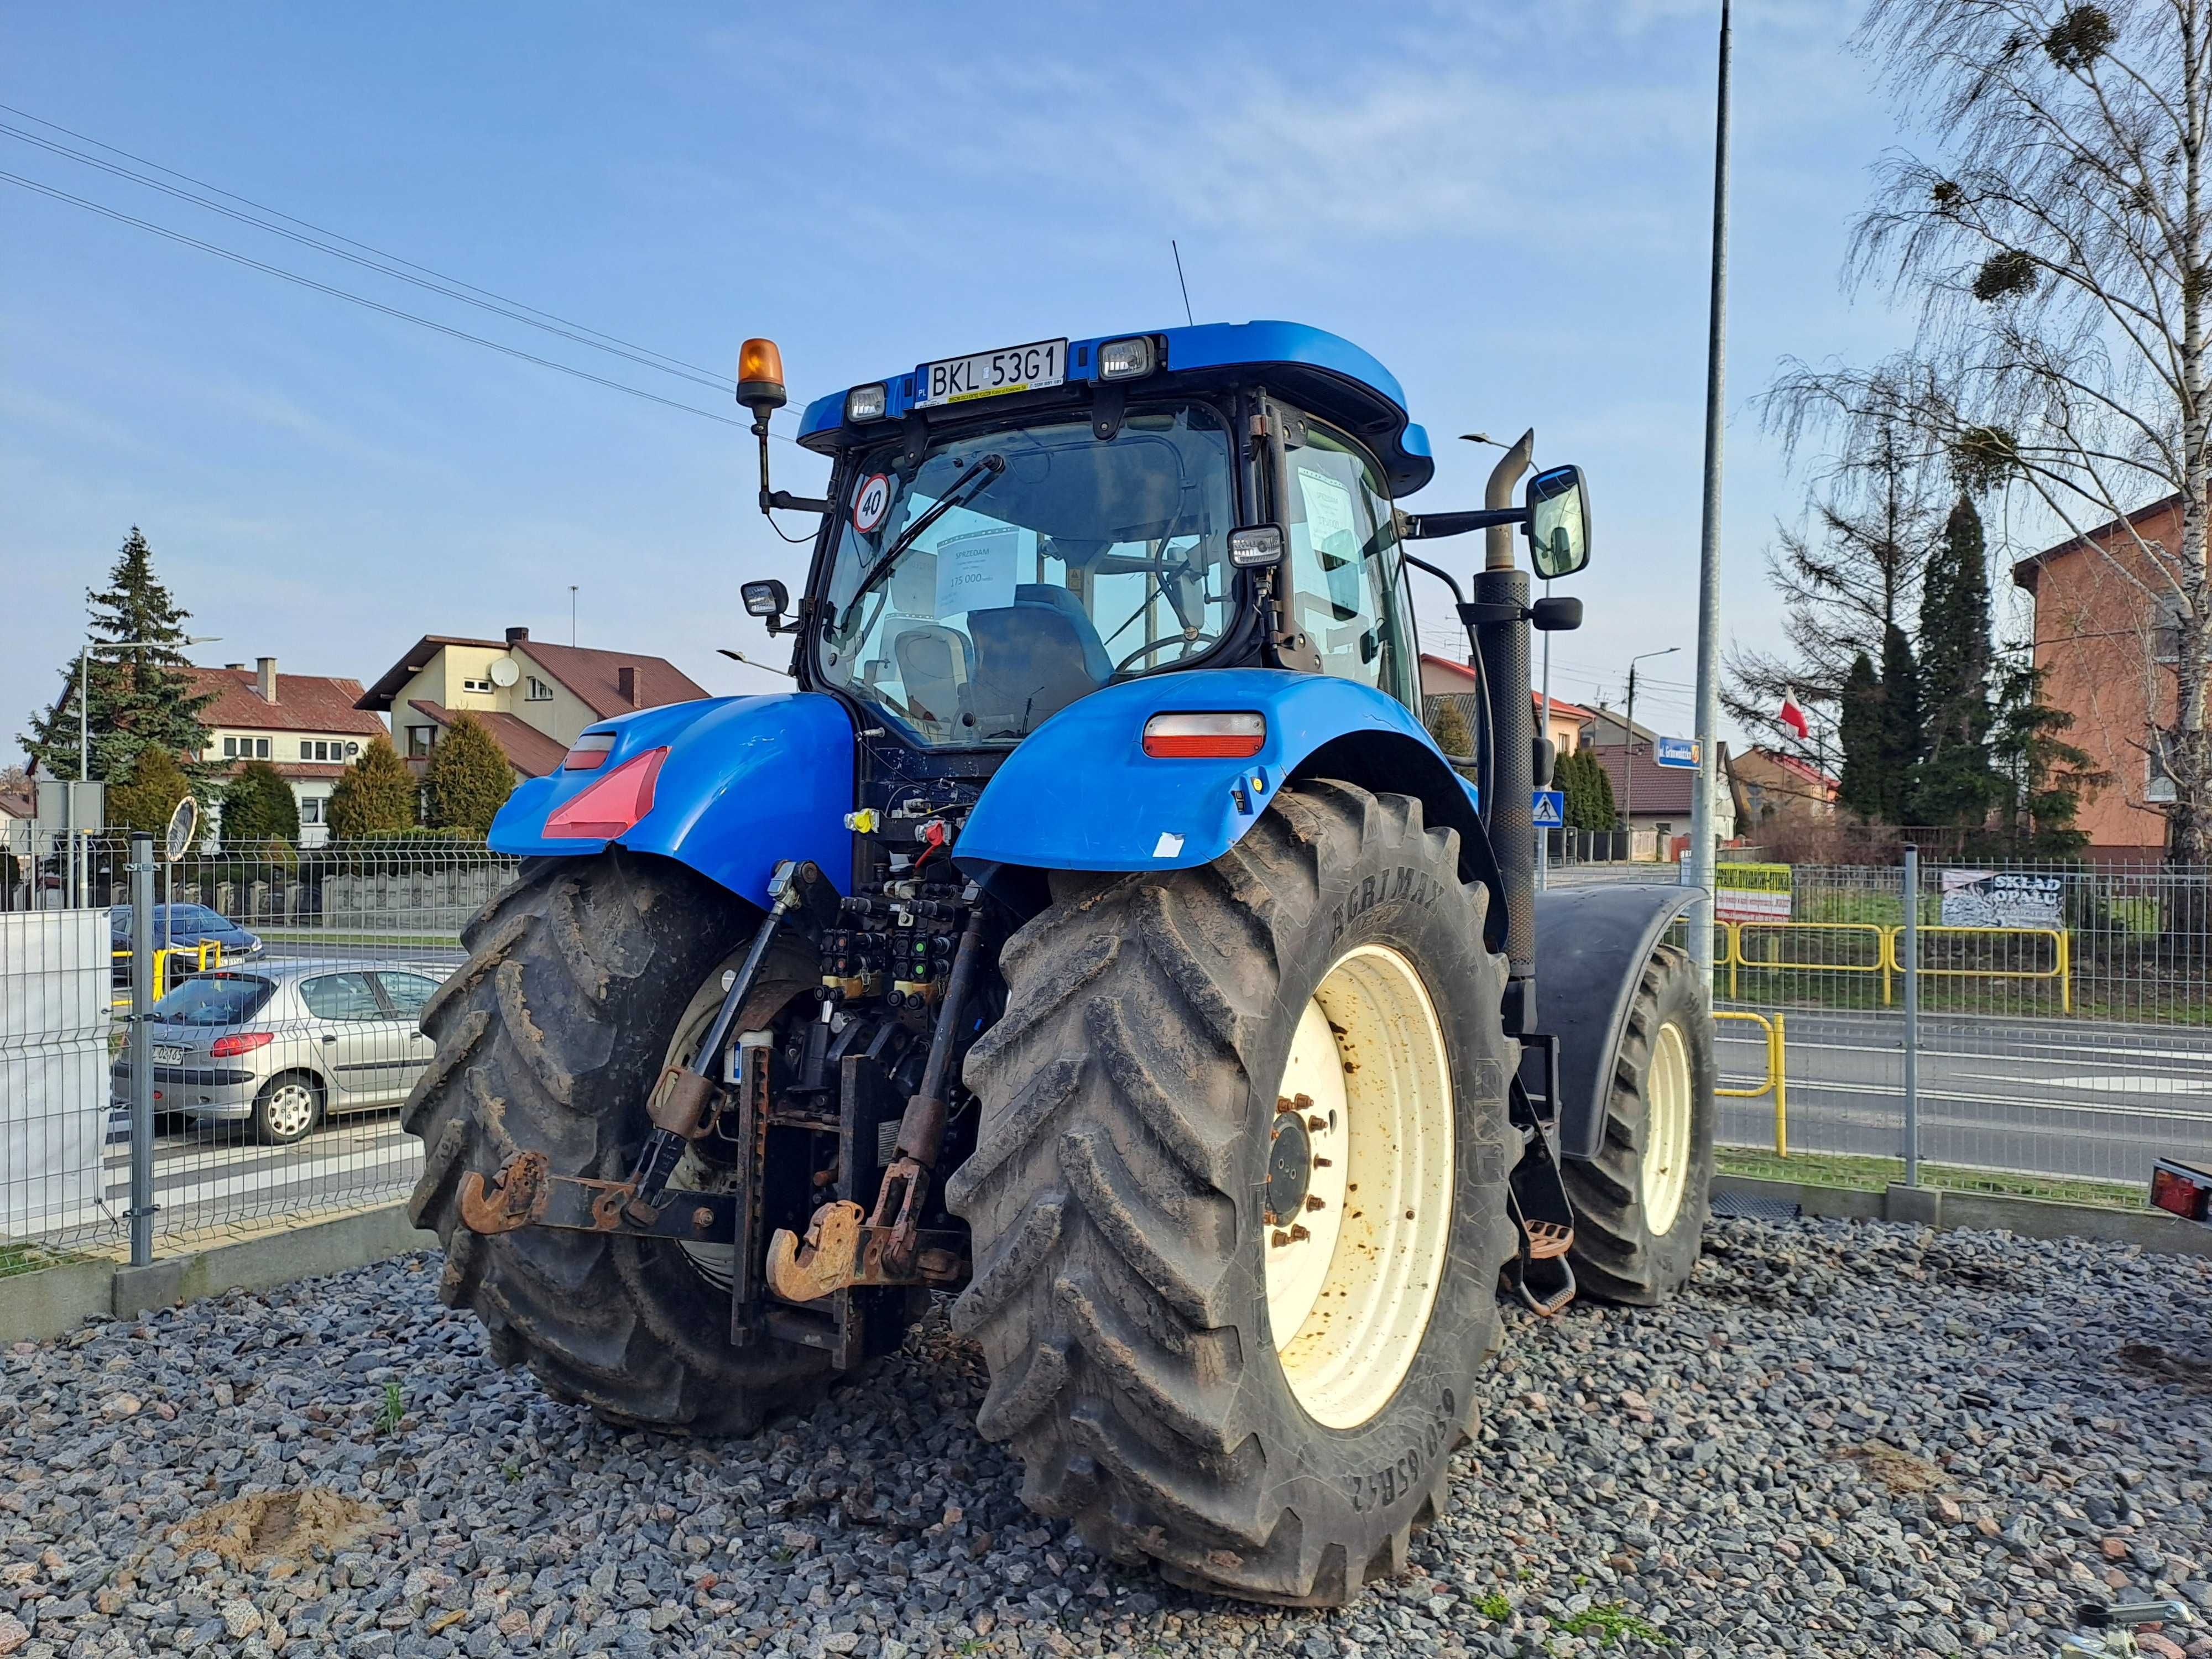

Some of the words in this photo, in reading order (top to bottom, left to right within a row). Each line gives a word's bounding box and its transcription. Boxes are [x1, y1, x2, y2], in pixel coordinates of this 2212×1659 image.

[933, 361, 979, 397] BKL
[992, 346, 1055, 386] 53G1
[918, 388, 926, 397] PL
[862, 490, 881, 517] 40
[956, 548, 989, 560] SPRZEDAM
[951, 576, 962, 587] 175
[965, 573, 982, 583] 000
[1994, 889, 2058, 905] OPAŁU
[1329, 866, 1445, 952] AGRIMAX
